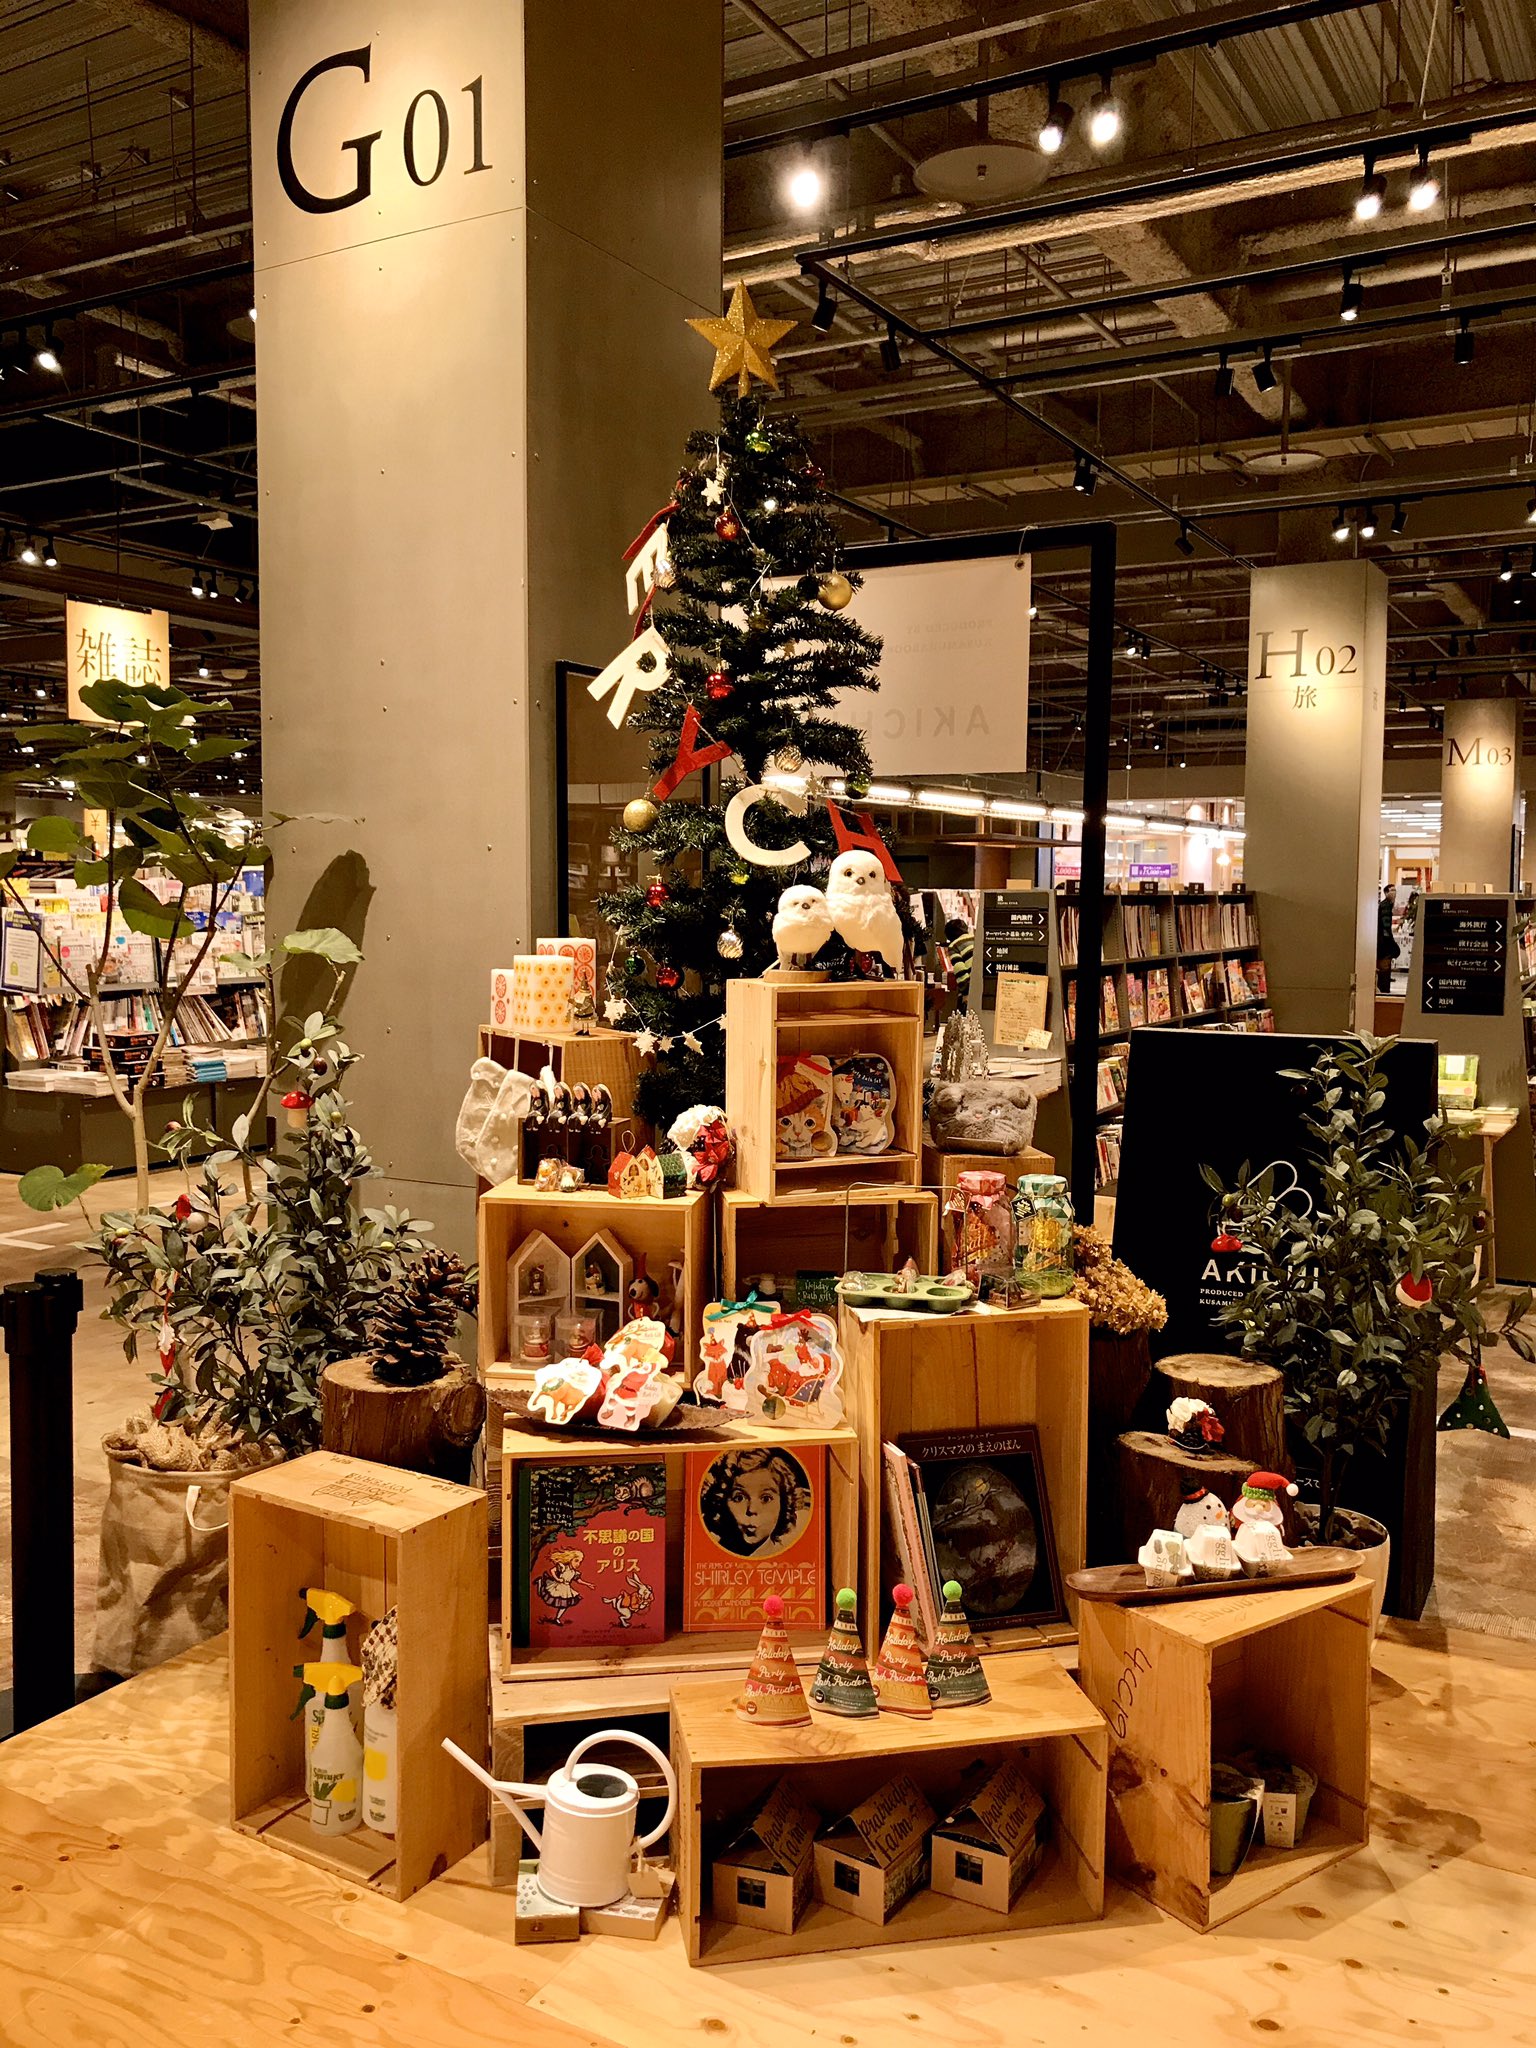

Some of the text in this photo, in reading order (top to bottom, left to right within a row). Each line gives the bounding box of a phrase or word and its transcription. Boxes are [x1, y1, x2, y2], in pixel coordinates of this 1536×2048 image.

[76, 628, 162, 688] 雑誌
[1292, 685, 1318, 710] 旅
[1200, 1288, 1244, 1297] PRODUCED
[922, 1443, 975, 1458] クリスマスの
[583, 1528, 655, 1544] 不思議の国
[612, 1545, 625, 1557] の
[597, 1558, 641, 1573] アリス
[694, 1569, 816, 1586] SHIRLEY TEMPLE
[885, 1632, 916, 1649] Holiday
[935, 1629, 972, 1646] Holiday
[756, 1647, 793, 1660] Holiday
[827, 1637, 860, 1655] Holiday
[883, 1652, 910, 1667] Party
[940, 1648, 968, 1664] Party
[827, 1656, 854, 1672] Party
[758, 1665, 787, 1680] Party
[889, 1670, 924, 1683] Powder
[925, 1663, 982, 1685] Bath Powder
[814, 1674, 870, 1687] Bath Powder
[745, 1683, 801, 1697] Bath Powder
